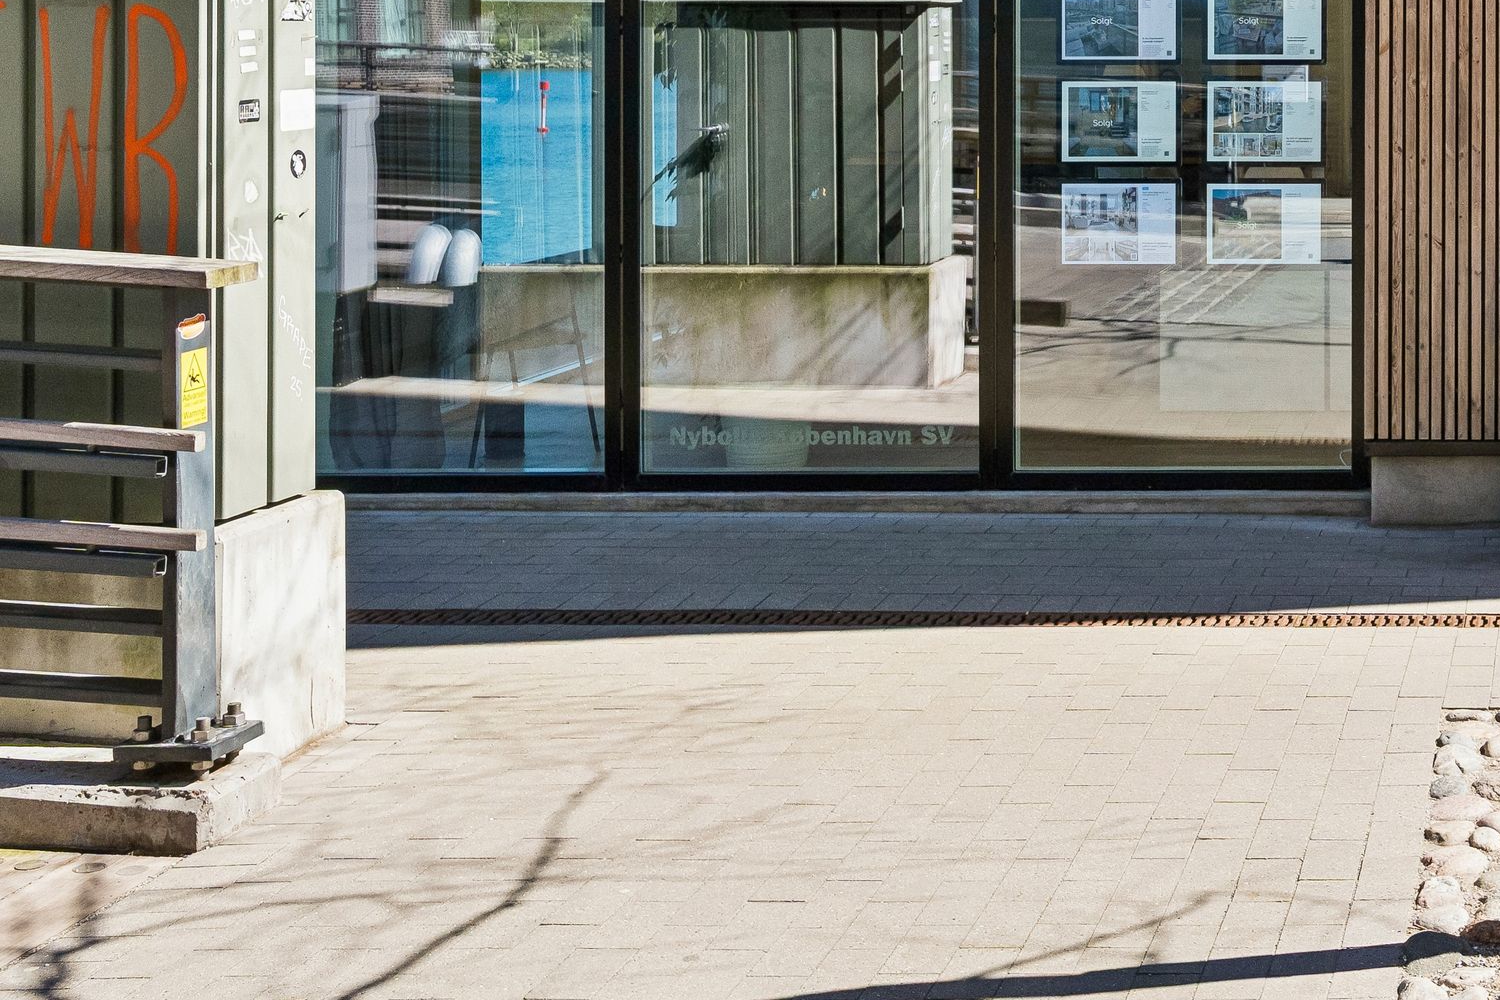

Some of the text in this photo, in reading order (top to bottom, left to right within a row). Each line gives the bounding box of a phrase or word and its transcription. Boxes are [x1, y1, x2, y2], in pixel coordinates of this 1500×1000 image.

[1091, 16, 1113, 26] Solgt
[1238, 16, 1260, 26] Solgt
[1092, 119, 1114, 128] Solgt
[920, 425, 955, 446] SV
